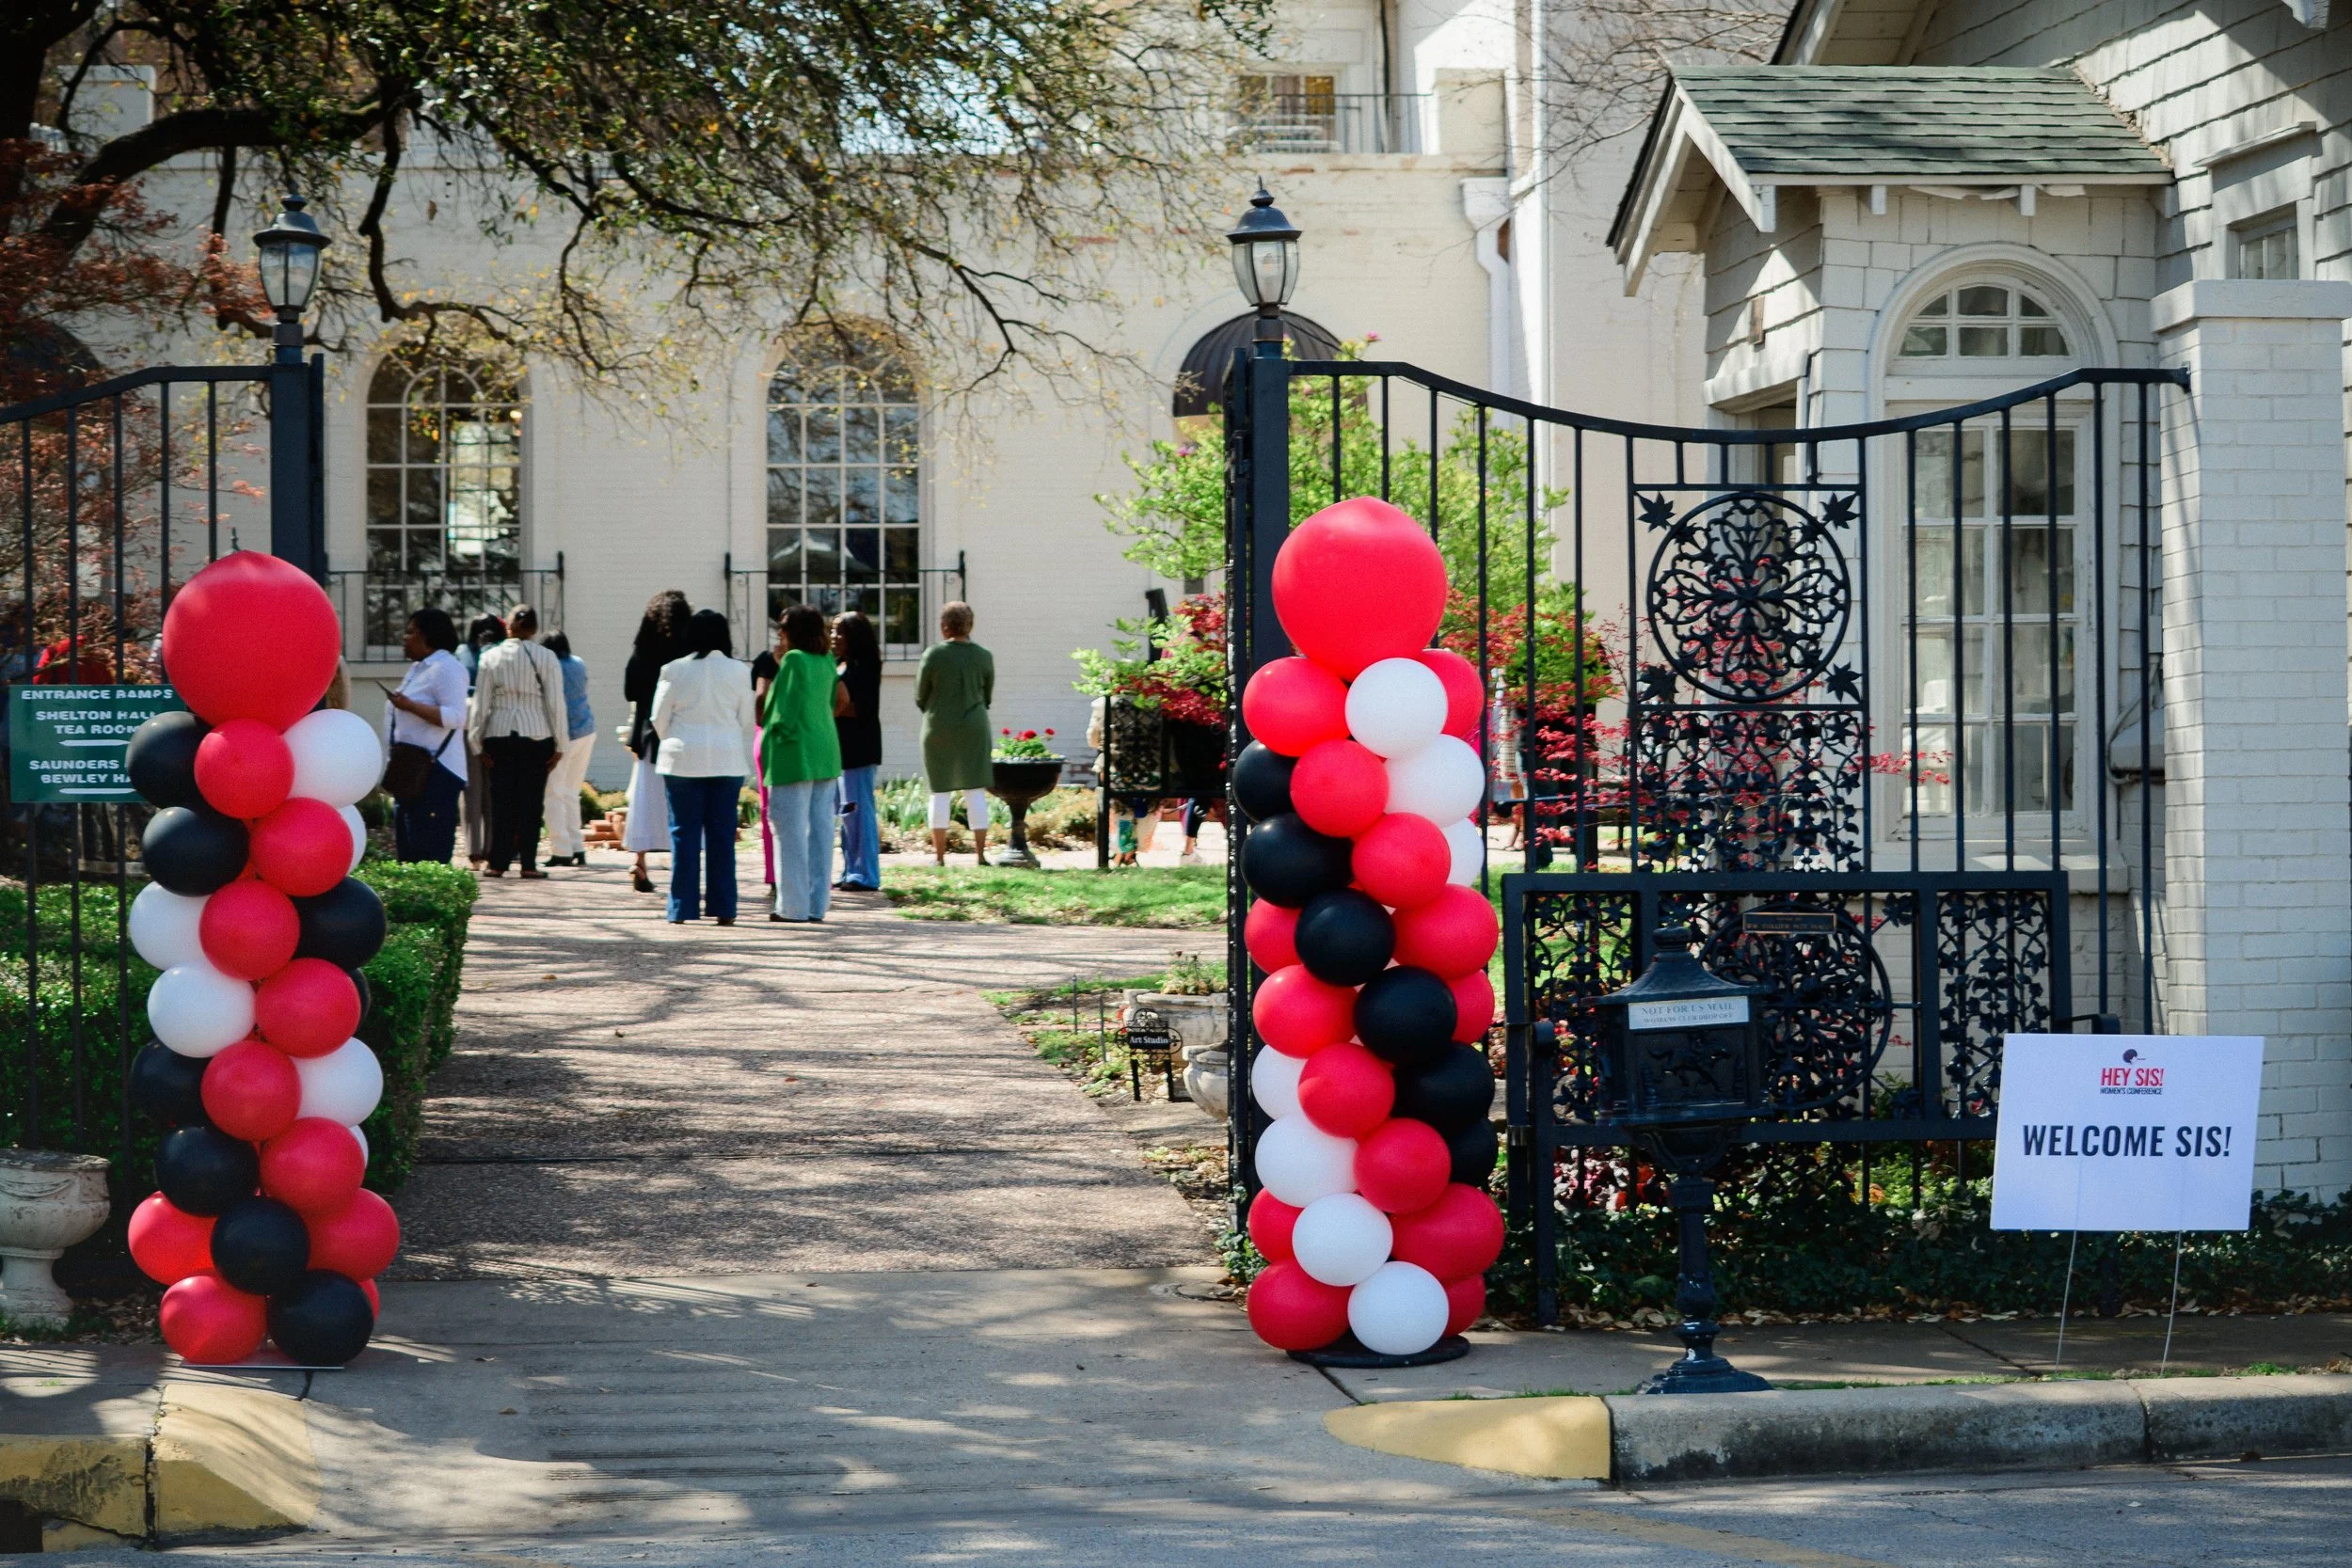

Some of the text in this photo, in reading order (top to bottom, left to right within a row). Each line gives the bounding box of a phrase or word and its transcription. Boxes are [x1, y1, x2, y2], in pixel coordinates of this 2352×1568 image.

[21, 689, 174, 700] ENTRANCE RAMPS
[35, 710, 112, 721] SHELTON
[54, 724, 87, 735] TEA
[29, 759, 119, 770] SAUNDERS
[40, 773, 108, 784] BEWLEY
[1642, 1006, 1662, 1015] NOT
[1666, 1005, 1688, 1014] FOR
[1708, 1003, 1736, 1011] MAIL
[1129, 1036, 1168, 1044] Art Studio
[2101, 1068, 2164, 1086] HEY SIS!
[2023, 1125, 2232, 1157] WELCOME SIS!
